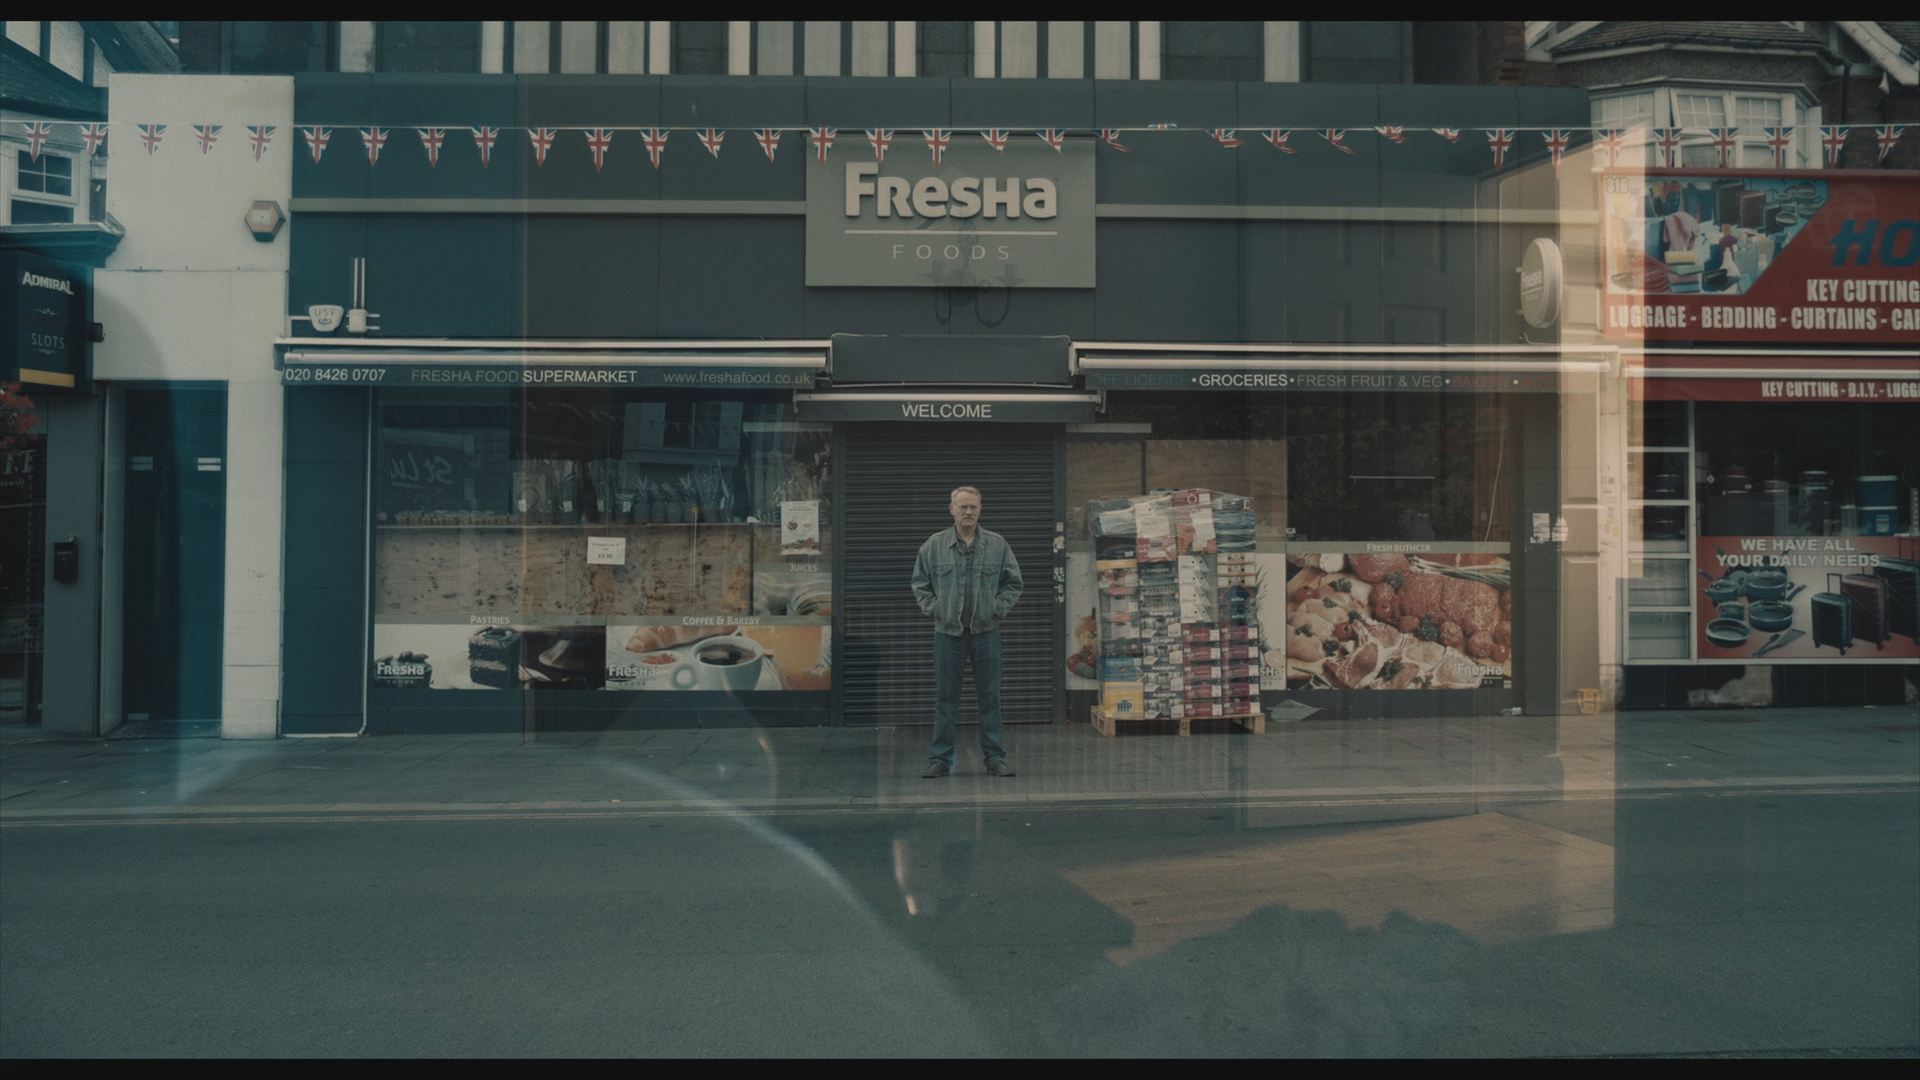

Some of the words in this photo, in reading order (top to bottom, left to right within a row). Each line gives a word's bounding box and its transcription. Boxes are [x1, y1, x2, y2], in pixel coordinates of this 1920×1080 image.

[1606, 177, 1629, 193] 316
[893, 244, 1009, 260] FOODS
[1807, 279, 1839, 302] KEY
[1843, 279, 1920, 303] CUTTING
[314, 308, 336, 316] USF
[1609, 305, 1687, 328] LUGGAGE
[1701, 306, 1776, 329] BEDDING
[1791, 308, 1877, 330] CURTAINS
[31, 333, 65, 349] SLOTS
[285, 368, 311, 381] 020
[314, 368, 348, 381] 8426
[352, 369, 386, 381] 0707
[411, 370, 472, 382] FRESHA
[475, 370, 519, 382] FOOD
[522, 370, 638, 383] SUPERMARKET
[663, 371, 811, 384] www.freshafood.co.uk
[1199, 374, 1287, 387] GROCERIES
[1297, 374, 1346, 387] FRESH
[1352, 375, 1394, 387] FRUIT
[1399, 375, 1408, 387] &
[1411, 375, 1443, 387] VEG
[1762, 382, 1783, 397] KEY
[1787, 382, 1838, 398] CUTTING
[901, 403, 992, 418] WELCOME
[1367, 543, 1393, 552] FRESH
[1741, 539, 1767, 551] WE
[1772, 539, 1818, 551] HAVE
[1823, 539, 1855, 551] ALL
[789, 563, 818, 572] JUICES
[1717, 555, 1764, 567] YOUR
[1770, 555, 1819, 567] DAILY
[1824, 555, 1880, 567] NEEDS
[470, 615, 510, 624] PASTRIES
[683, 616, 714, 625] COFFEE
[716, 616, 725, 625] &
[727, 616, 760, 625] BAKERY
